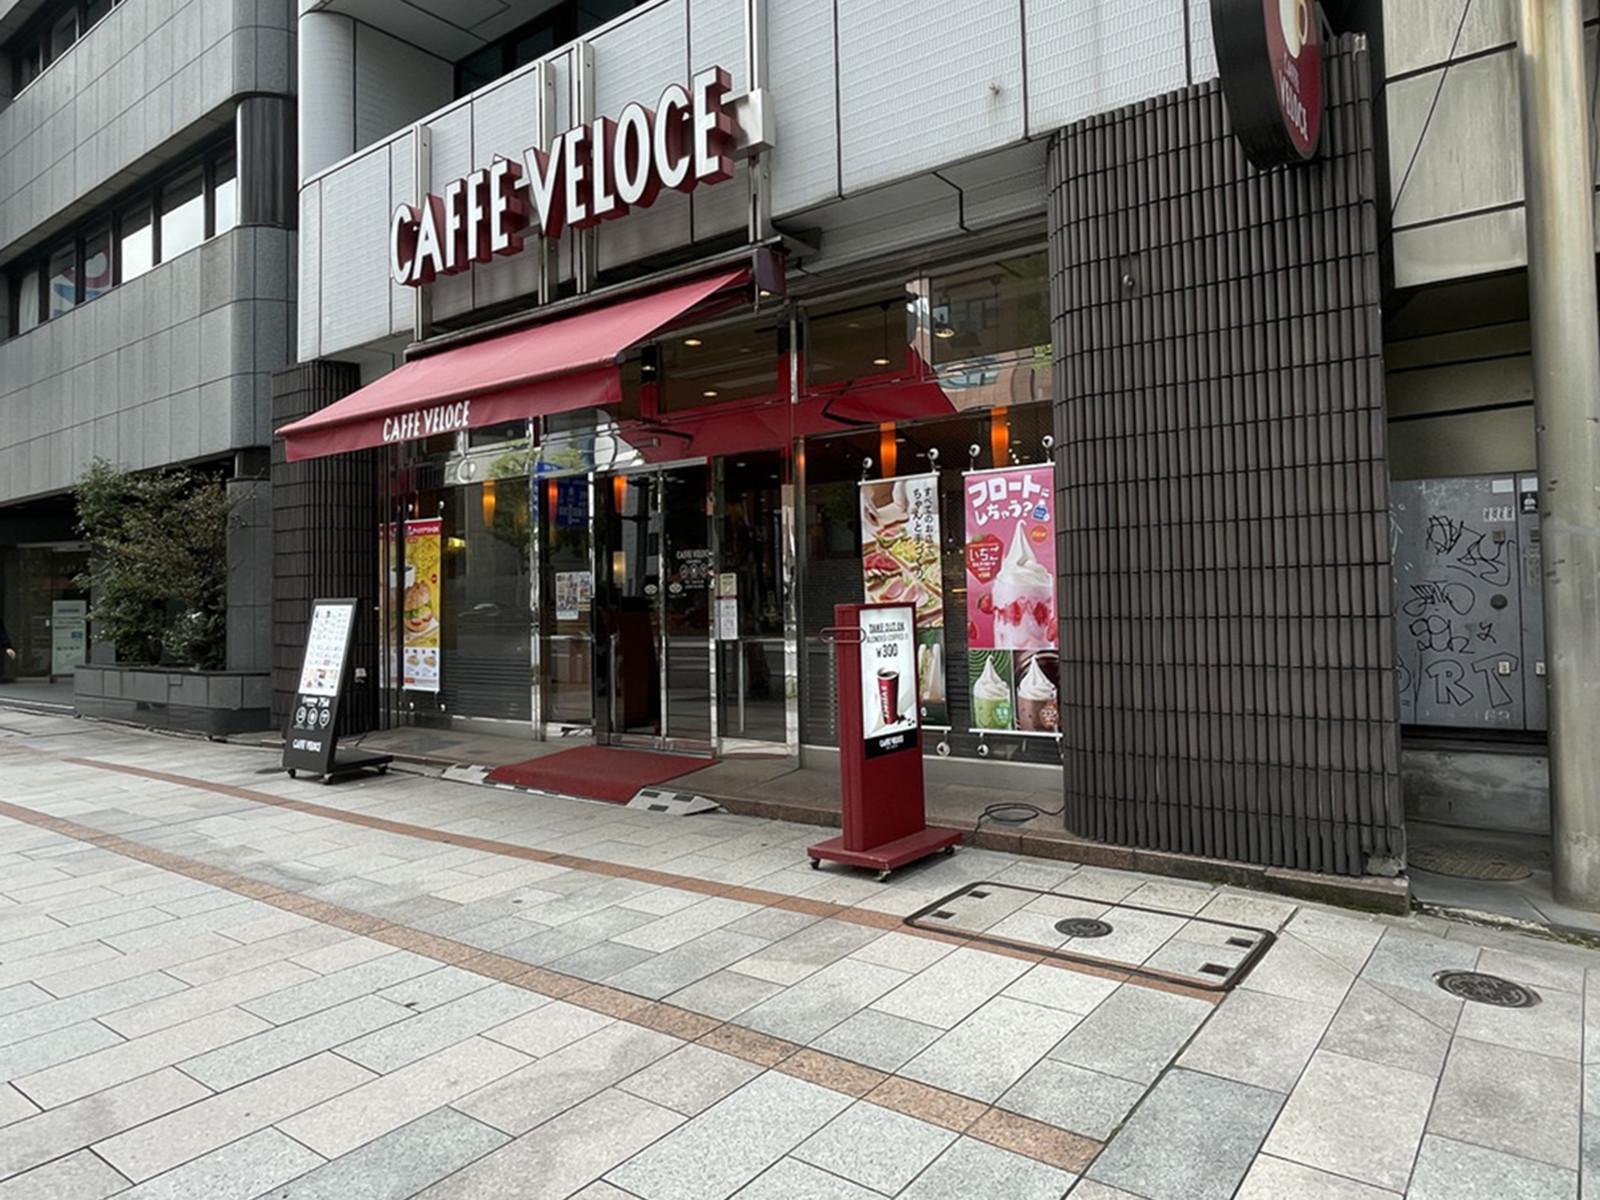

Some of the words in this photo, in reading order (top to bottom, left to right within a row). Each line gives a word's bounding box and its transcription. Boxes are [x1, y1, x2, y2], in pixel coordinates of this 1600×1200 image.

[523, 65, 722, 235] VELOCE
[423, 400, 470, 434] VELOCE
[969, 546, 1000, 562] いちご
